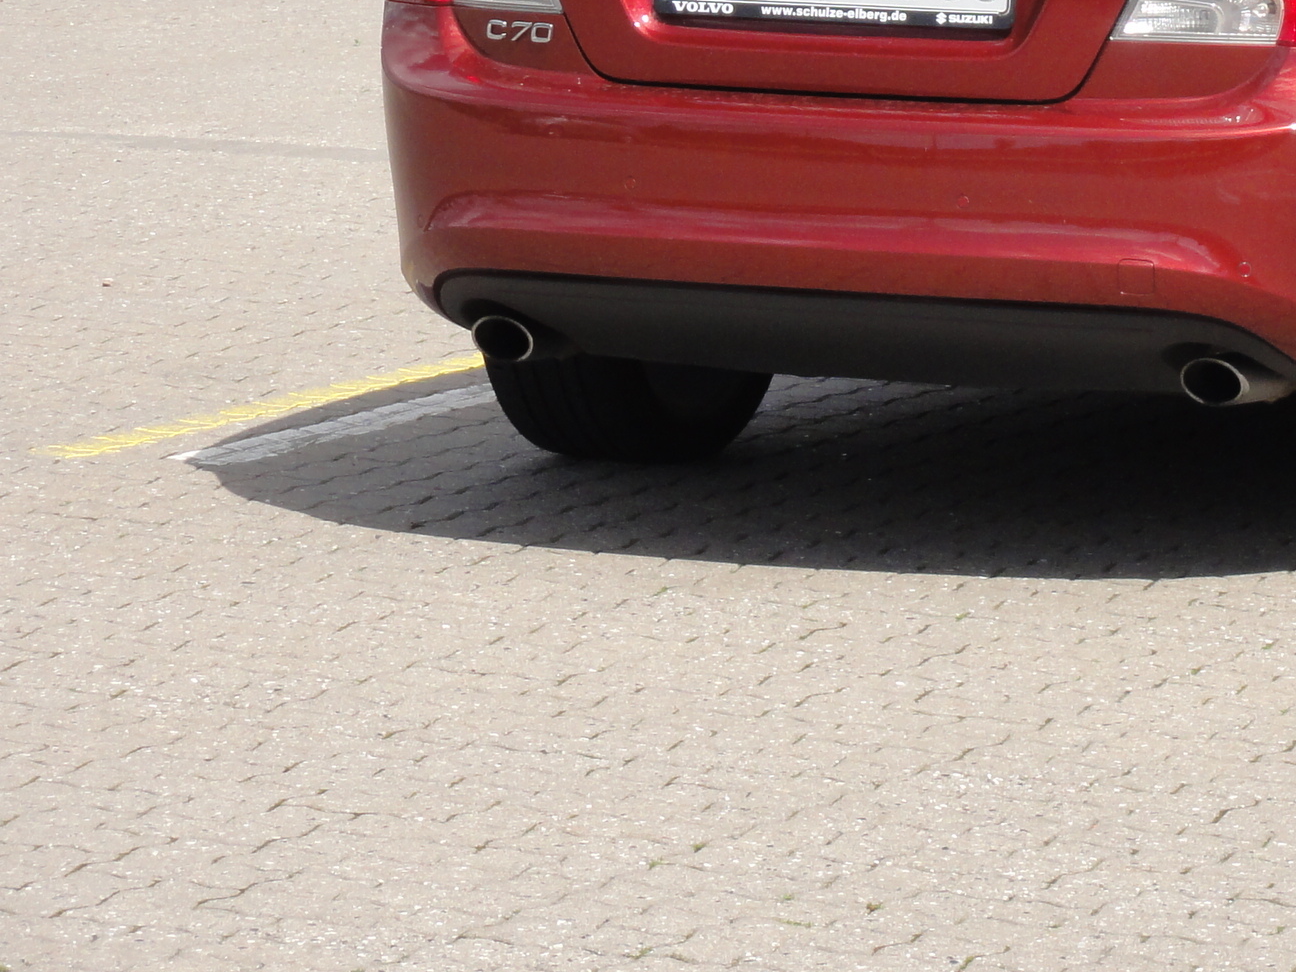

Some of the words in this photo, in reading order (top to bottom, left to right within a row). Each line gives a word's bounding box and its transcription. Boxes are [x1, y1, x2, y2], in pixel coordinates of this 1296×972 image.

[672, 0, 734, 15] VOLVO
[761, 4, 907, 23] www.schulze-elberg.de
[948, 13, 993, 25] SUZUKI
[486, 19, 554, 43] C70
